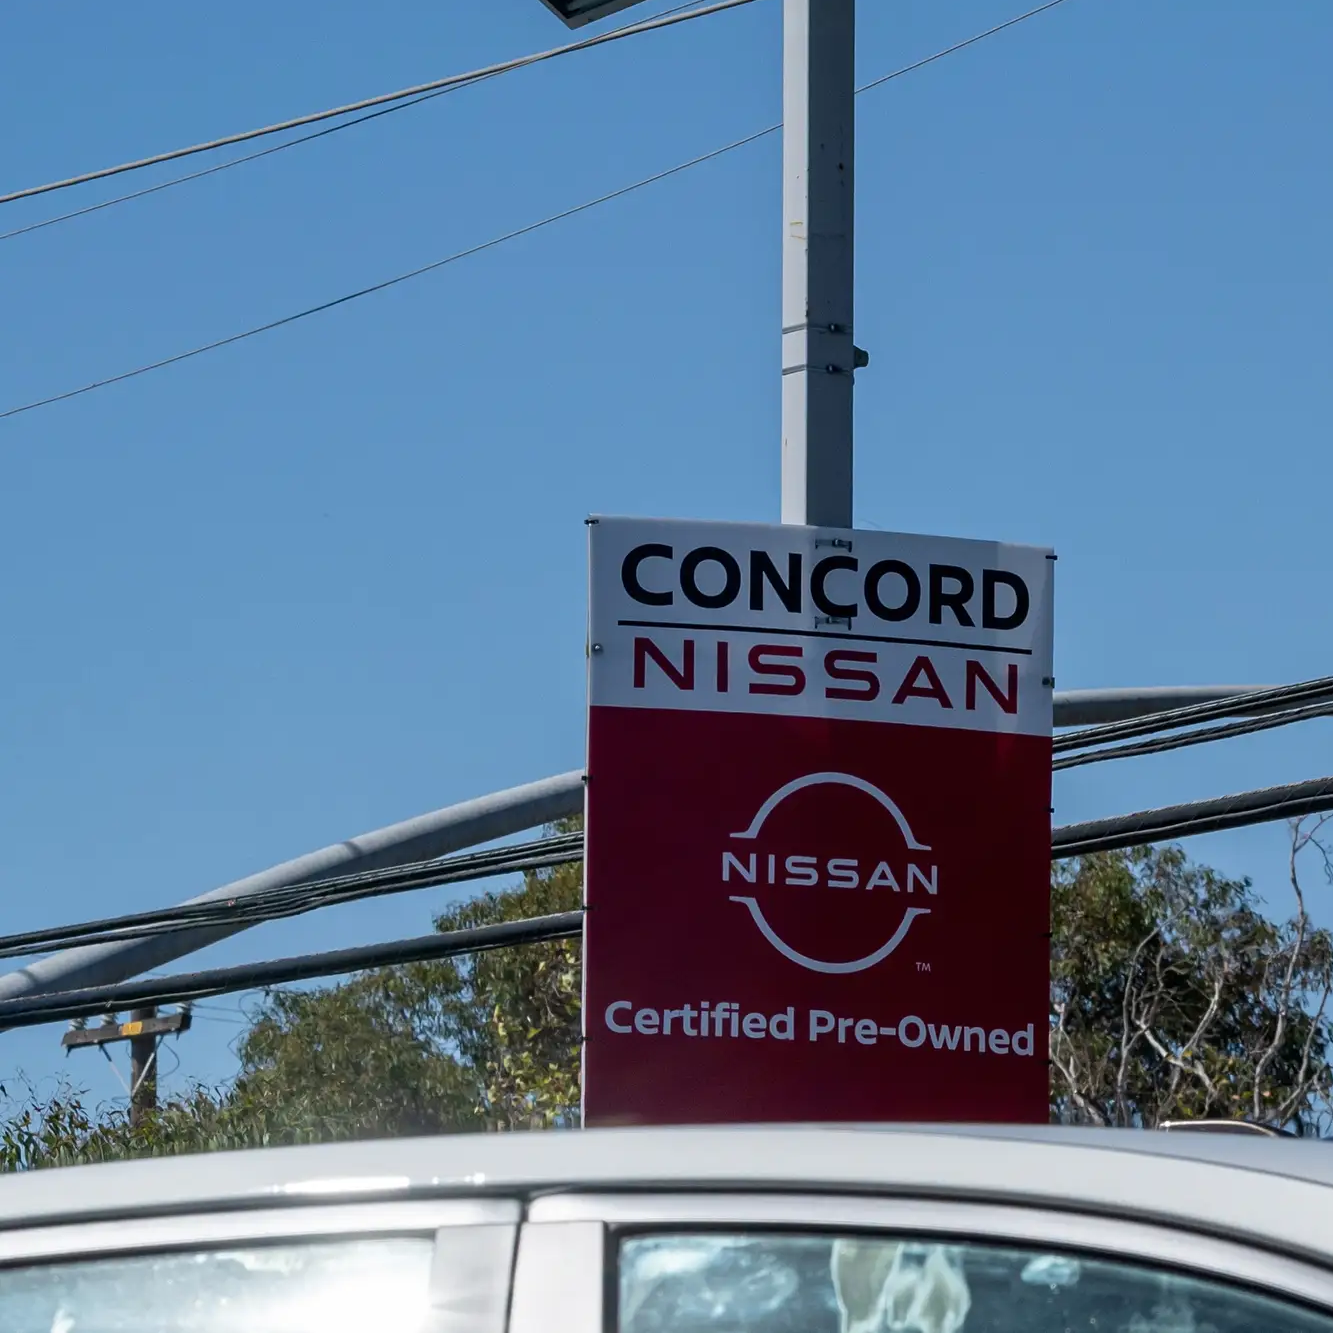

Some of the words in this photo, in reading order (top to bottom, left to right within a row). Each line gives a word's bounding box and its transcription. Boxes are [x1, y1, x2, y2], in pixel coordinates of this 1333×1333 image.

[620, 542, 1031, 631] CONCORD
[632, 636, 1019, 715] NISSAN
[721, 851, 938, 895] NISSAN
[604, 999, 795, 1041] Certified
[808, 1008, 1035, 1057] Pre-Owned
